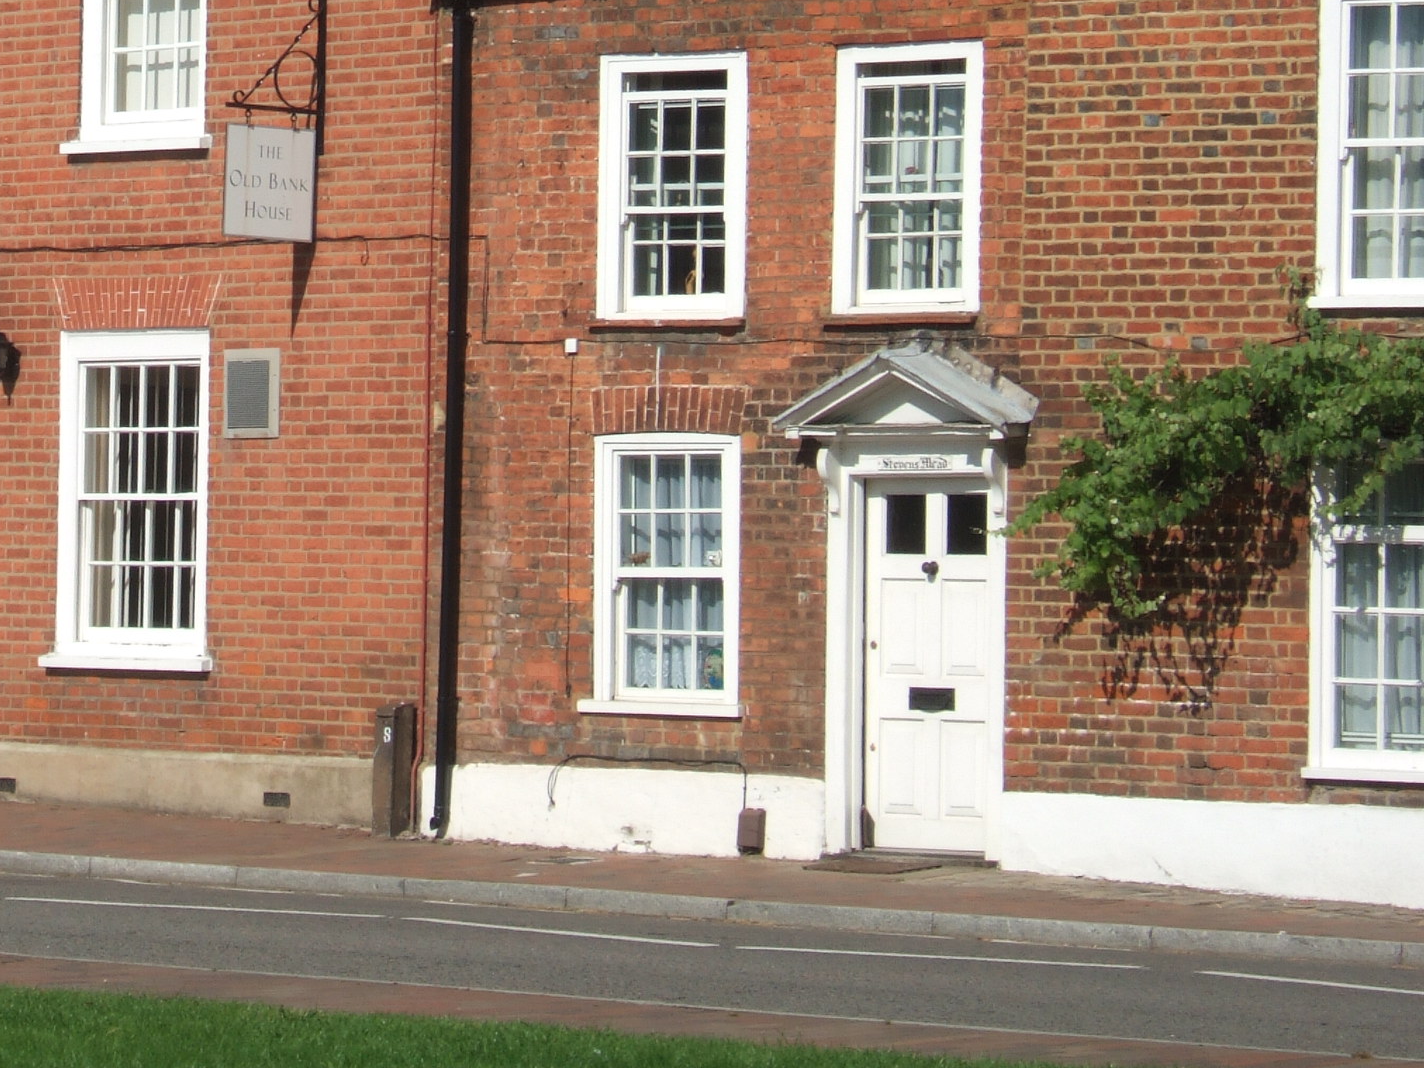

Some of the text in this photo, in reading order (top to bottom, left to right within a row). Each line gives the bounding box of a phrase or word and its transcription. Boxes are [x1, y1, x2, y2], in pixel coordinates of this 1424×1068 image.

[259, 144, 283, 160] THE
[229, 169, 308, 192] OLD BANK
[244, 200, 293, 221] HOUSE
